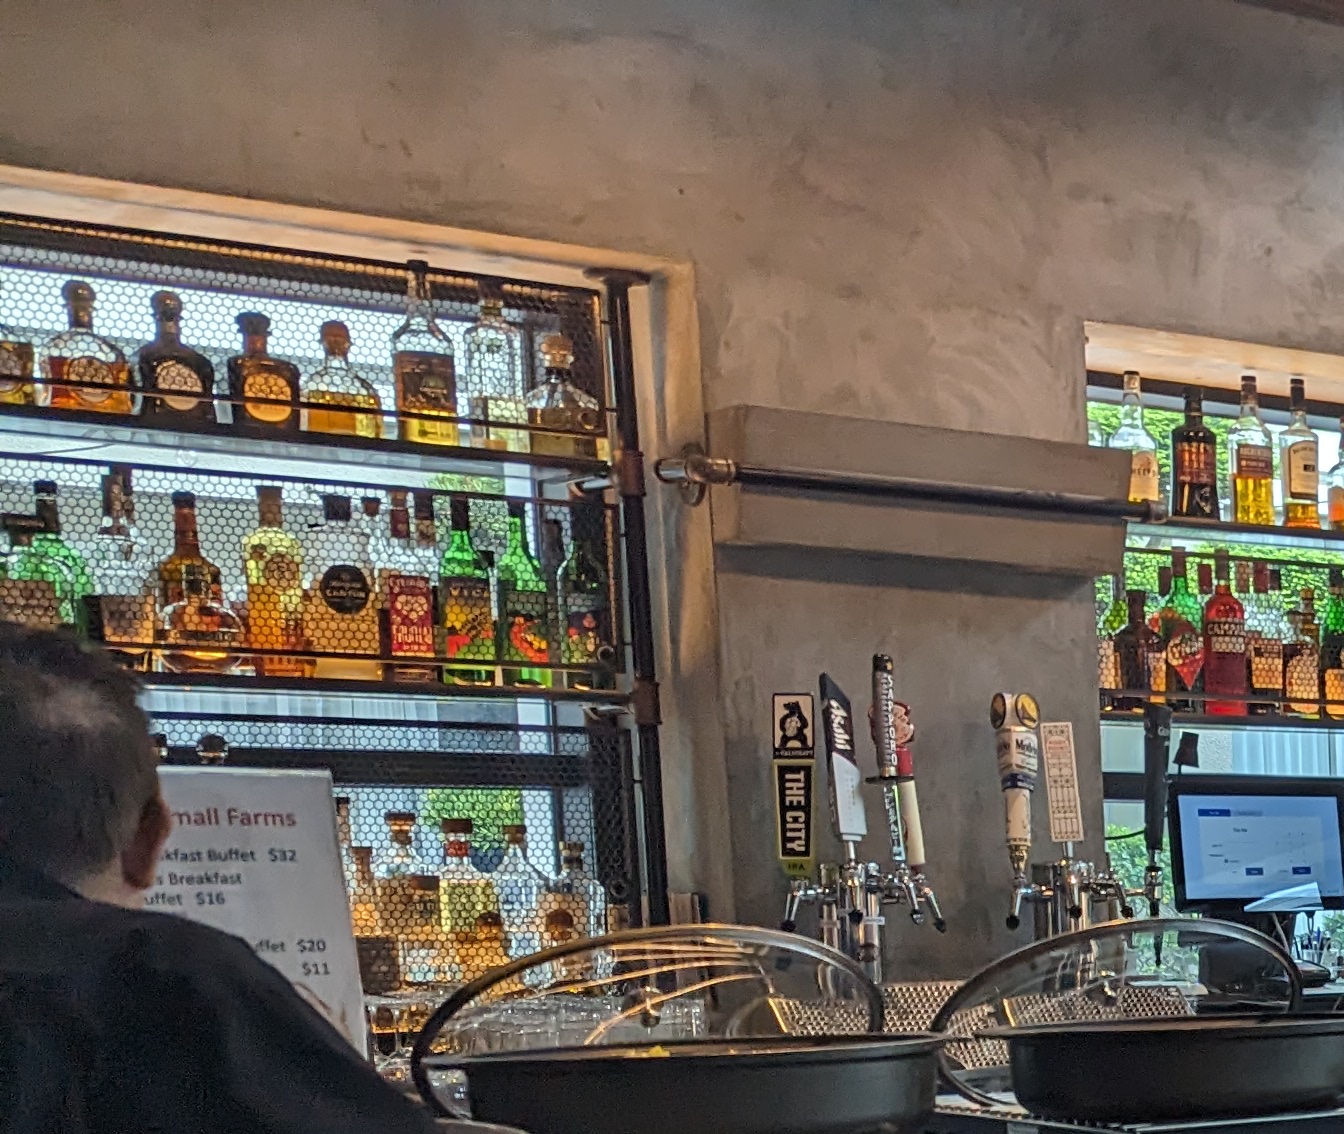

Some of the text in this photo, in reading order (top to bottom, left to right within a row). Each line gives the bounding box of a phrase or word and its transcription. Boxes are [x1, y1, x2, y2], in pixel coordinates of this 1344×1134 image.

[829, 699, 852, 751] Asahi
[885, 674, 898, 767] SAPPORO
[784, 770, 805, 807] THE
[171, 807, 298, 827] mall Farms
[785, 810, 806, 852] CITY
[207, 848, 256, 862] Buffet
[168, 872, 242, 885] Breakfast
[143, 894, 183, 906] uffet
[297, 938, 326, 953] $20
[302, 961, 330, 976] $11
